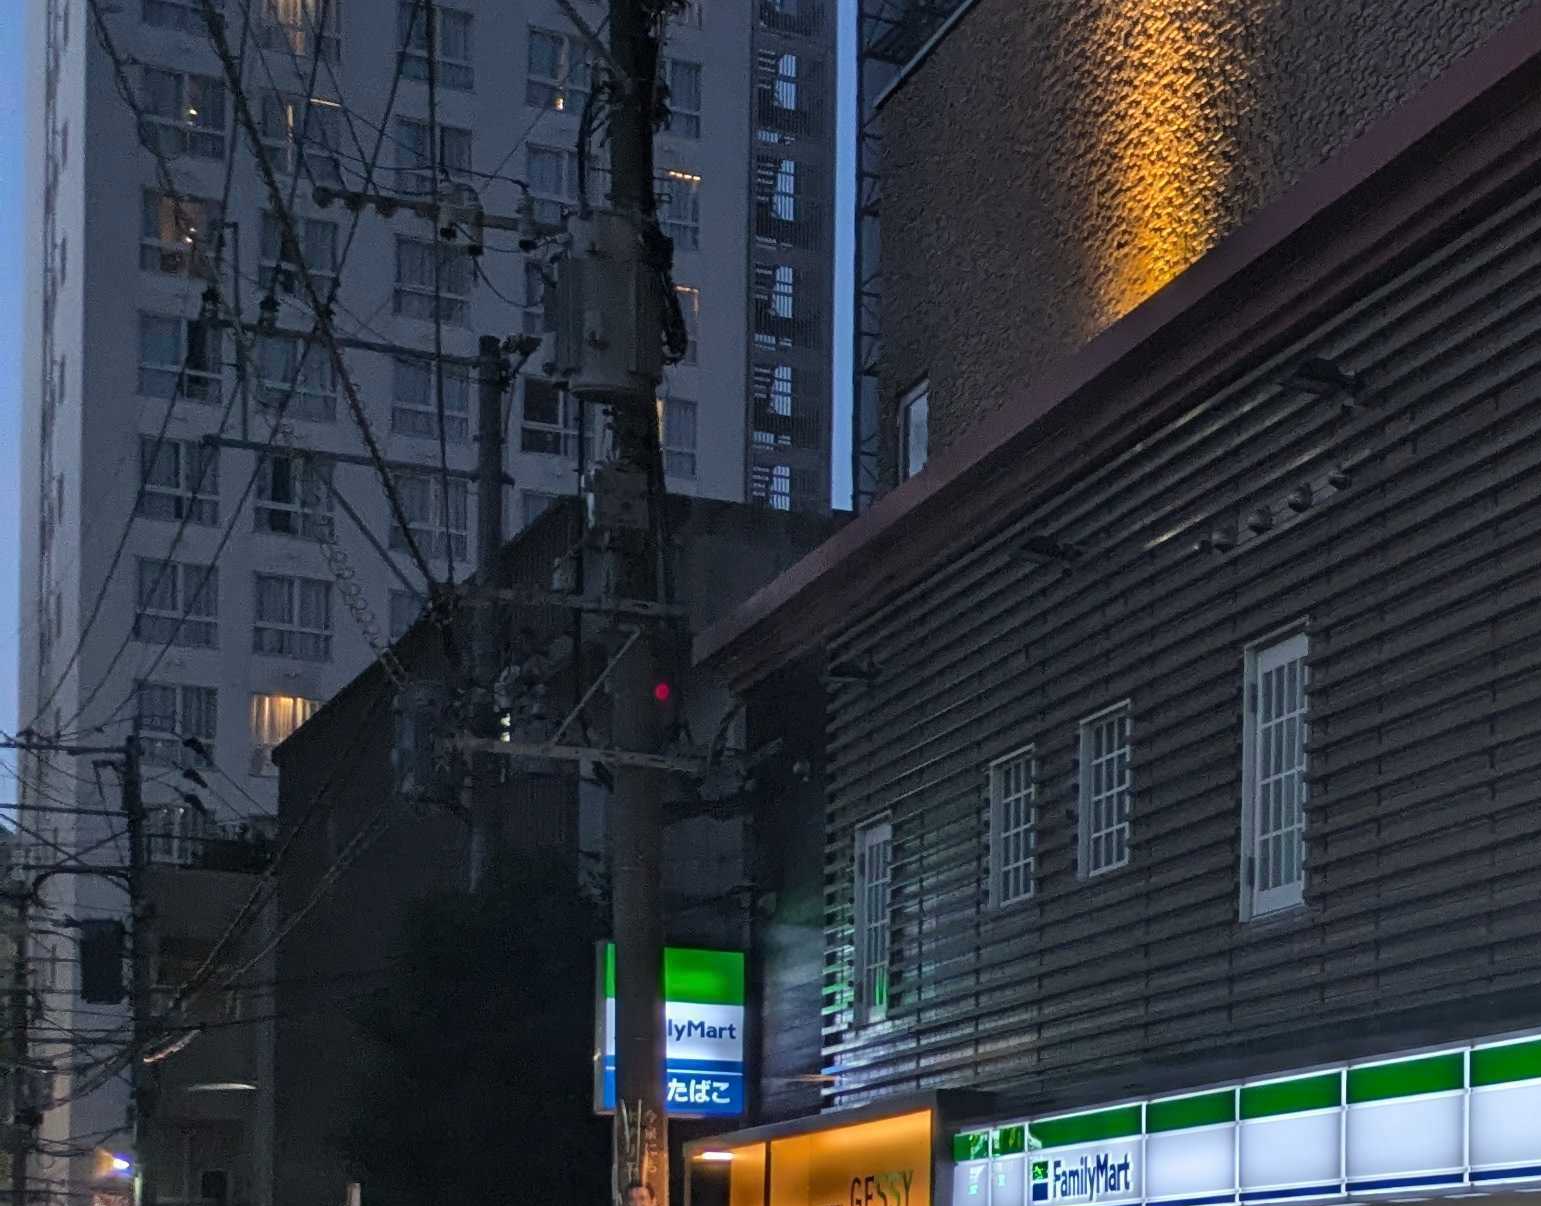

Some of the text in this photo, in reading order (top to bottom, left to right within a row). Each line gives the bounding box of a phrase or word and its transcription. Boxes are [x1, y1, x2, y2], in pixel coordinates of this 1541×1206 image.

[667, 1019, 736, 1041] lyMart
[667, 1078, 731, 1103] たばこ
[1053, 1152, 1130, 1202] FamilyMart
